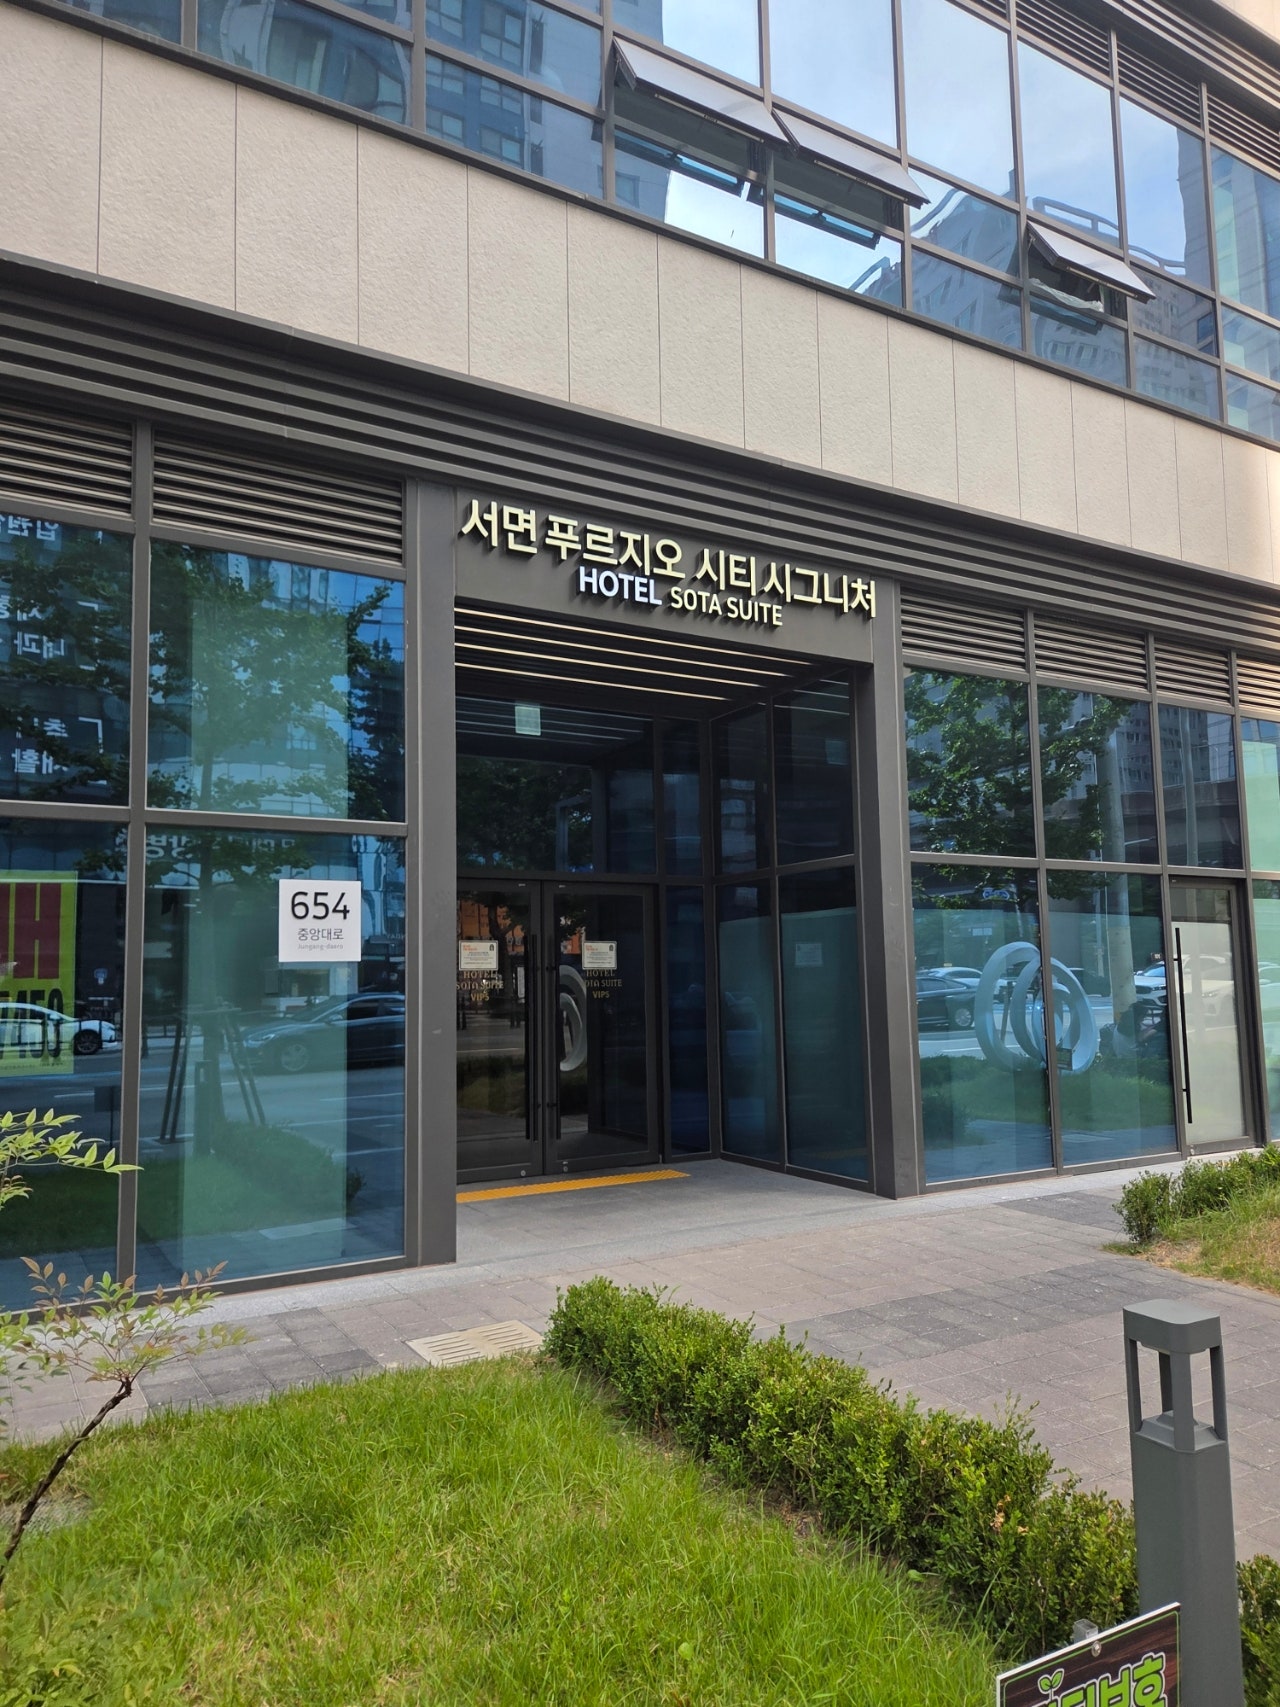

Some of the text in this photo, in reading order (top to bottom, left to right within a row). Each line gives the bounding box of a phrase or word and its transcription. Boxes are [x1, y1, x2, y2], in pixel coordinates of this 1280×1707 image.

[461, 499, 876, 618] 서면 푸르지오 시티 시그니처
[580, 566, 783, 626] HOTEL SOTA SUITE
[291, 891, 350, 920] 654
[297, 928, 344, 941] 중앙대로
[464, 970, 496, 979] HOTEL
[586, 969, 615, 977] HOTEL
[592, 990, 609, 999] VIPS
